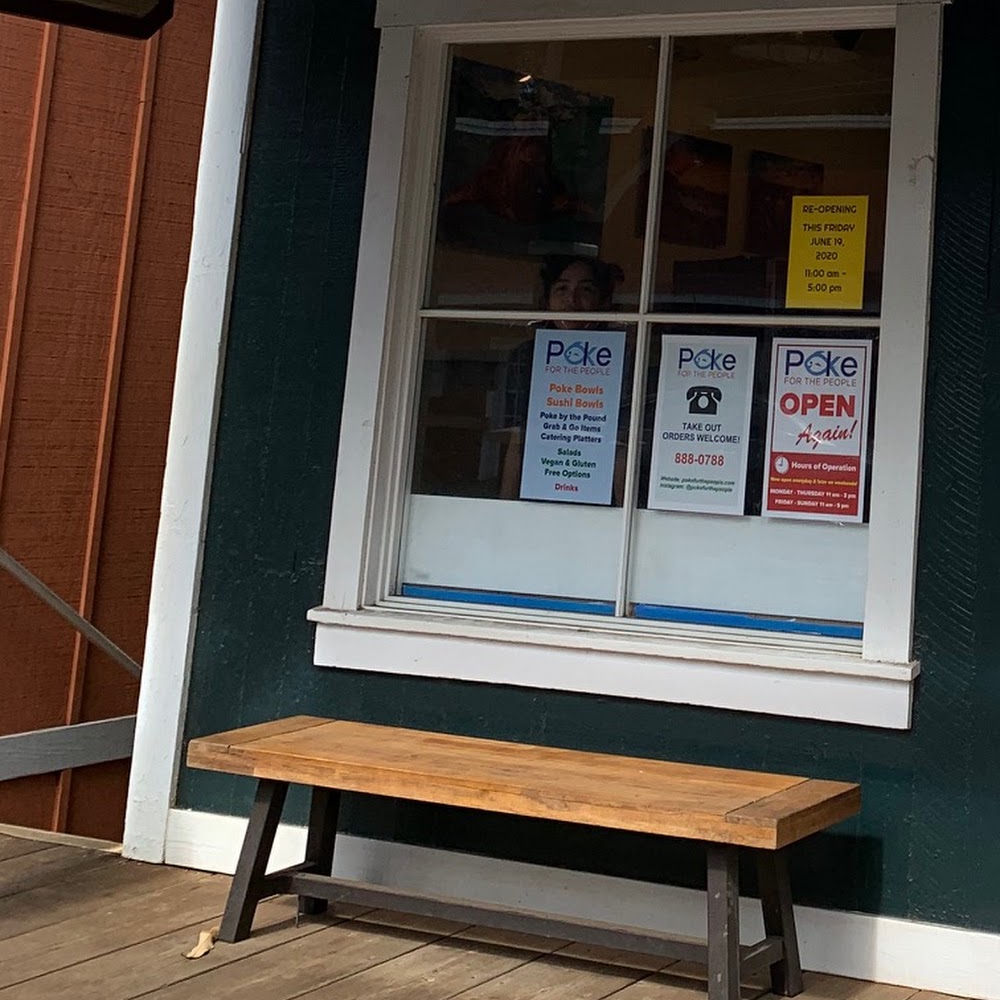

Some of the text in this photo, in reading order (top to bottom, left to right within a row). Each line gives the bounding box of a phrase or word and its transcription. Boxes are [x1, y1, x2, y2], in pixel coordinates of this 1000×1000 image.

[803, 205, 856, 213] RE-OPENING
[824, 224, 855, 232] FRIDAY
[810, 238, 832, 246] JUNE
[816, 252, 838, 260] 2020
[805, 269, 824, 277] 11:00
[808, 284, 842, 293] 5:00 pm
[546, 341, 612, 367] Poke
[678, 348, 736, 371] Poke
[785, 350, 858, 377] Poke
[580, 368, 610, 376] PEOPLE
[708, 371, 735, 379] PEOPLE
[784, 377, 857, 387] FOR THE PEOPLE
[549, 383, 604, 394] Poke Bowls
[546, 398, 604, 409] Sushi Bowls
[779, 393, 856, 417] OPEN
[559, 413, 568, 421] by
[583, 414, 606, 422] Pound
[581, 424, 601, 432] Items
[682, 423, 703, 431] TAKE
[541, 433, 601, 443] Catering Platters
[662, 432, 740, 443] ORDERS WELCOME!
[795, 419, 858, 450] Again!
[558, 448, 581, 456] Salads
[541, 458, 563, 467] Vegan
[572, 460, 596, 468] Gluten
[675, 453, 724, 466] 888-0788
[822, 463, 856, 472] Operation
[562, 470, 590, 479] Options
[555, 483, 578, 492] Drinks
